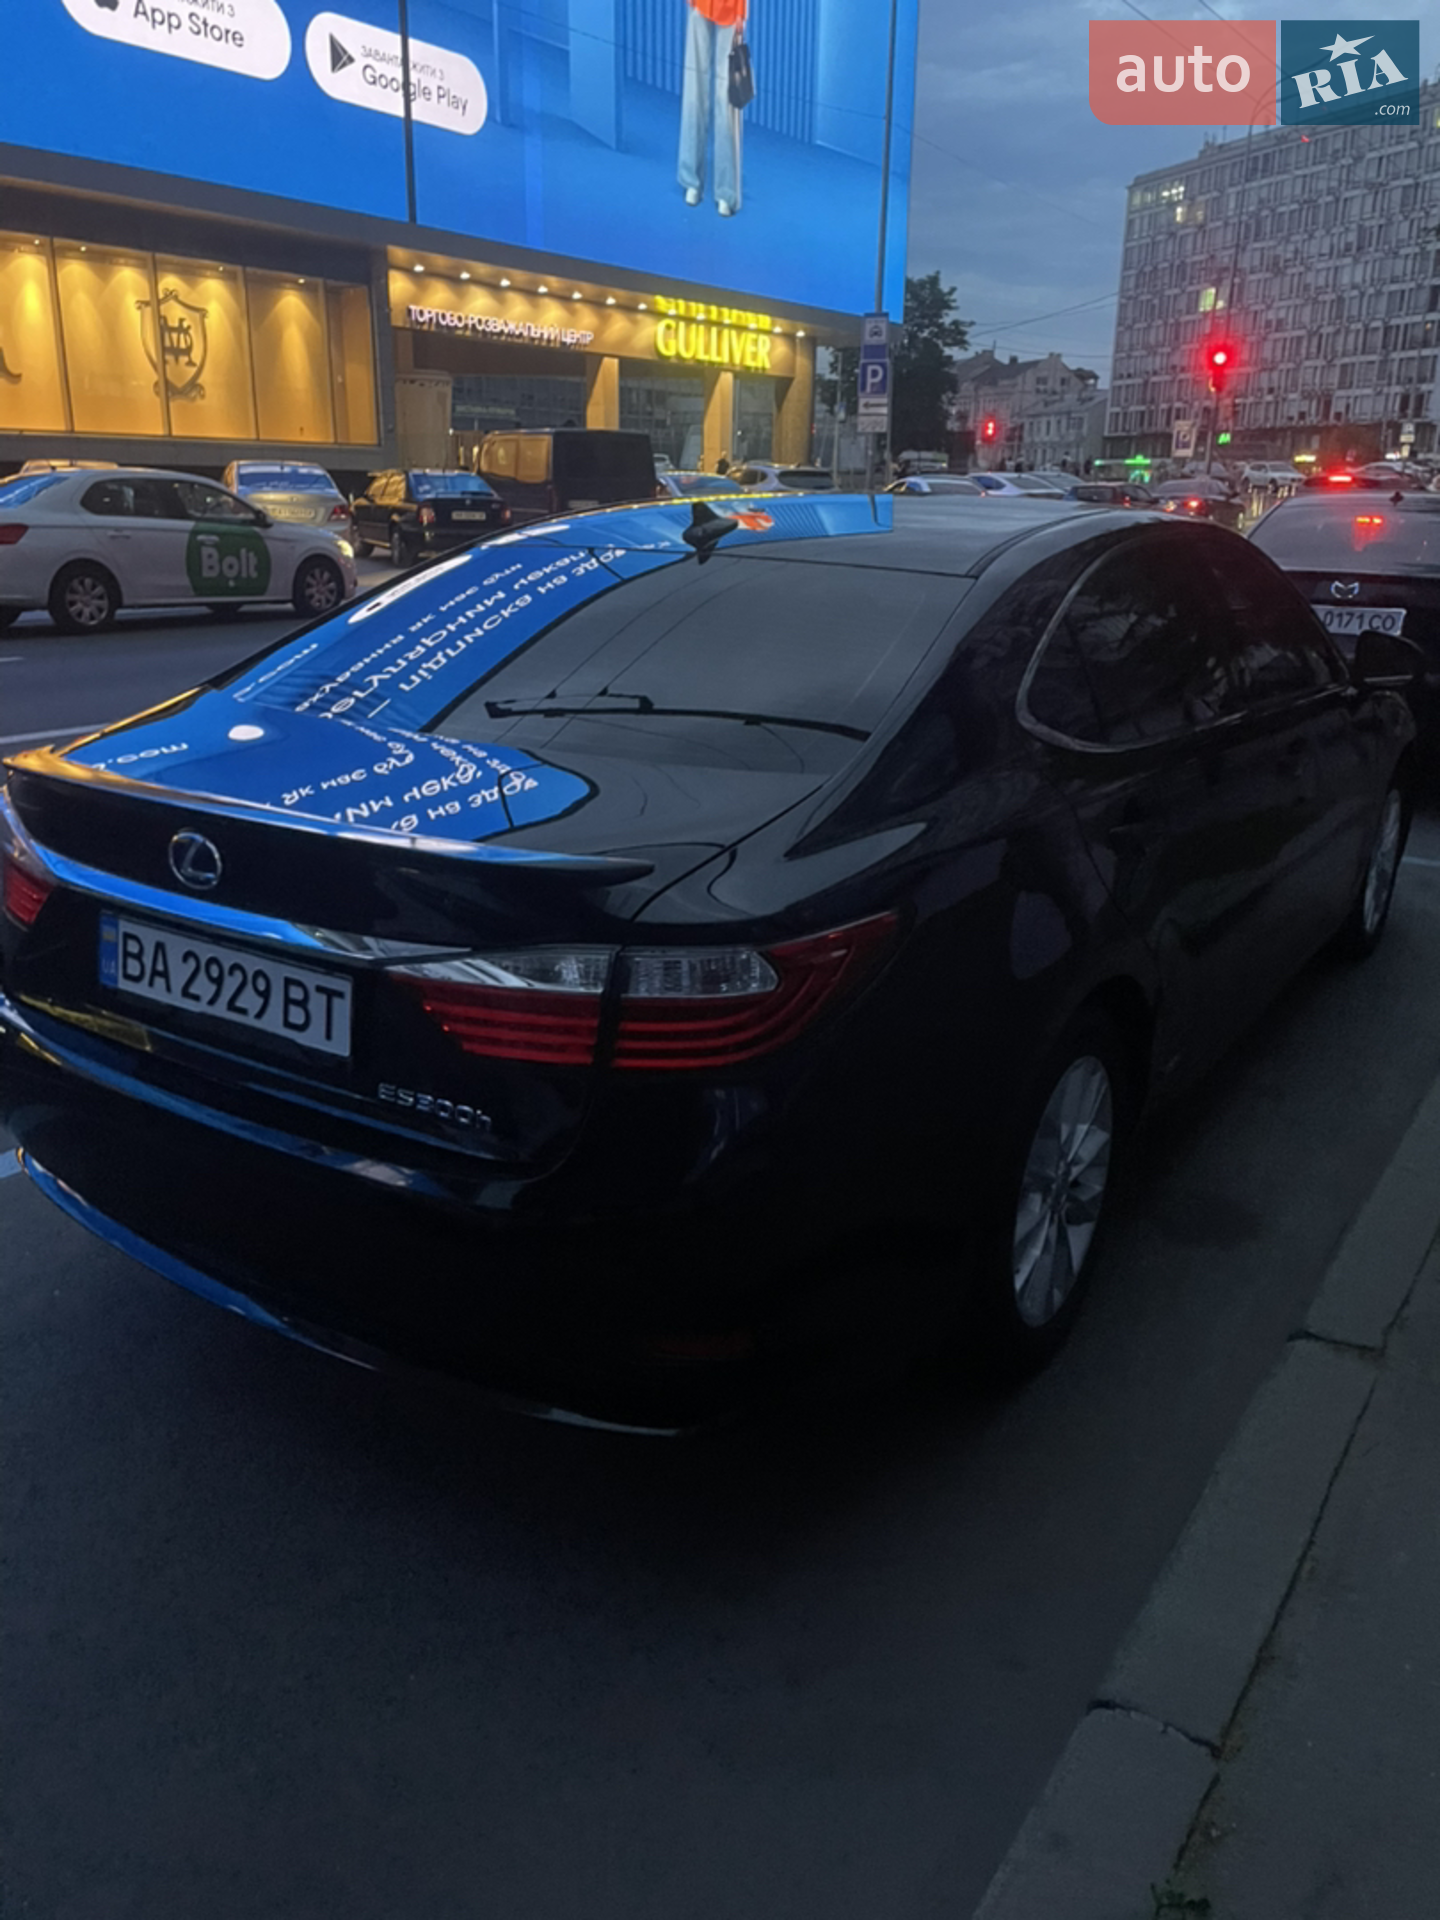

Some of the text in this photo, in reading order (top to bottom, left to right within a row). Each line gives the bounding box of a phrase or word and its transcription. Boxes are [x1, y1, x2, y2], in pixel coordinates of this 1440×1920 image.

[133, 0, 245, 48] App Store
[437, 85, 468, 117] Play
[655, 317, 772, 370] GULLIVER
[866, 364, 884, 394] P
[201, 546, 258, 587] Bolt
[122, 931, 346, 1042] BA 2929 BT
